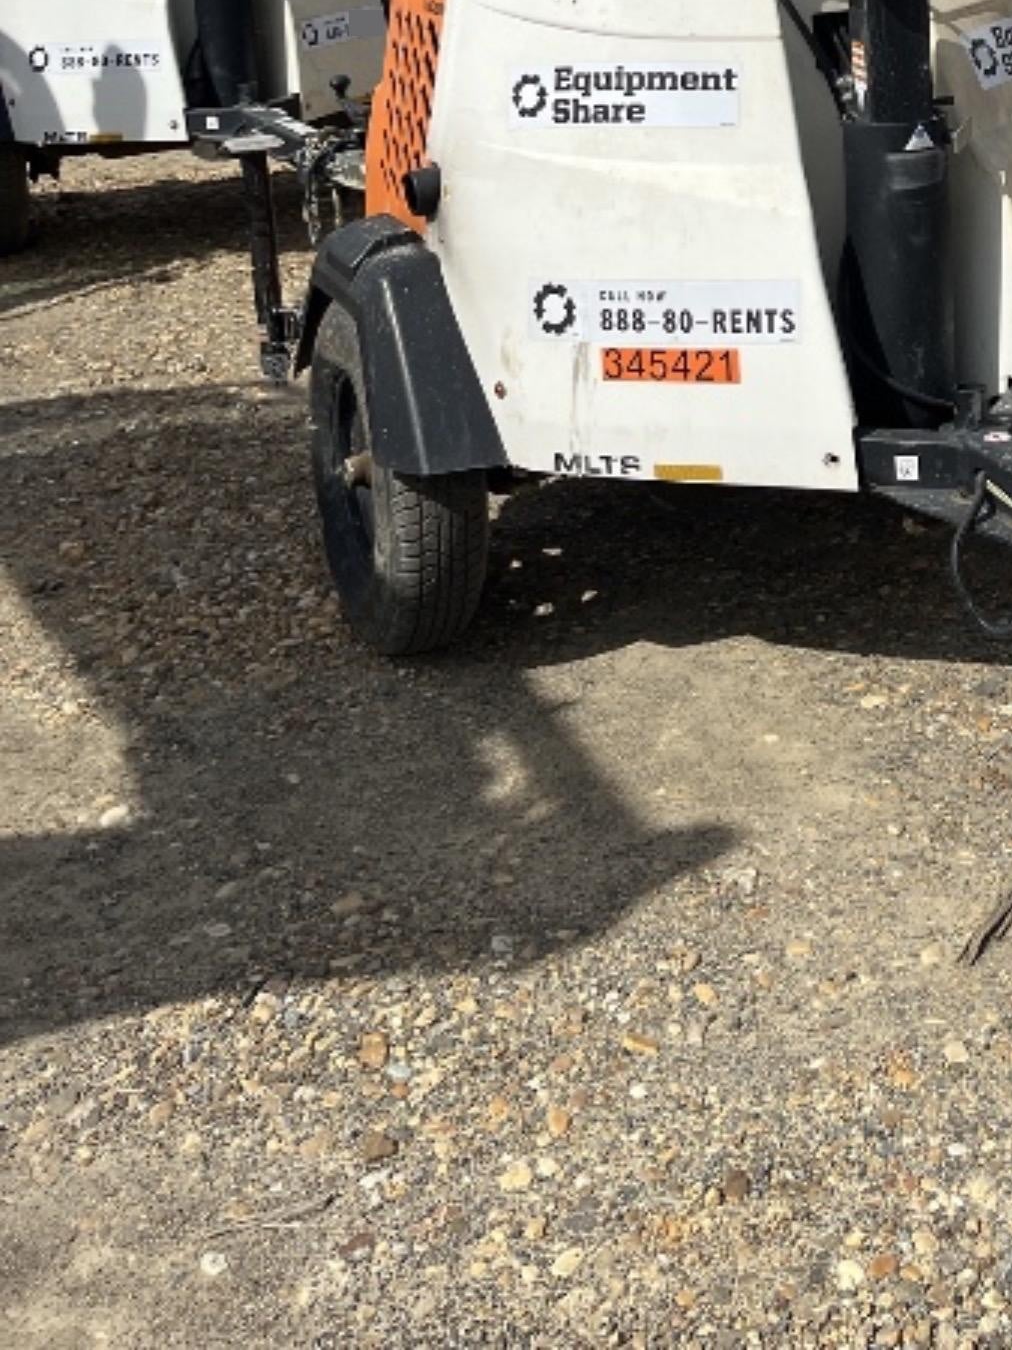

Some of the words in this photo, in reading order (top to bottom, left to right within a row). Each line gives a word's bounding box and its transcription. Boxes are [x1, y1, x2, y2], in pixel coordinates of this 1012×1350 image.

[554, 65, 738, 97] Equipment
[551, 98, 646, 125] Share
[600, 308, 796, 334] 888-80-RENTS
[604, 349, 733, 381] 345421
